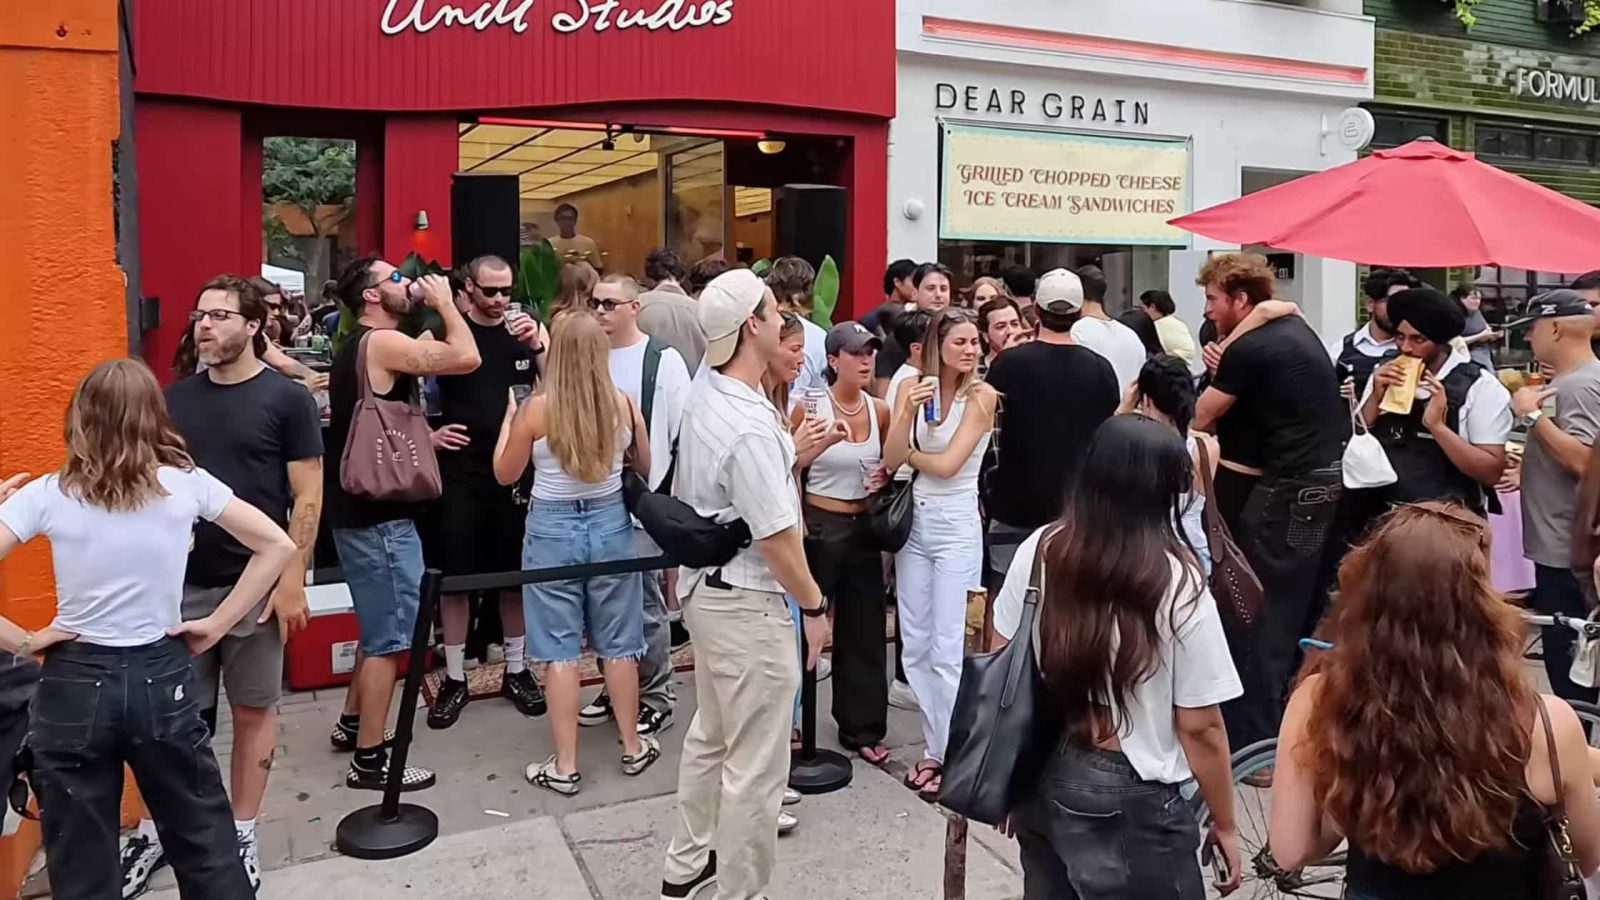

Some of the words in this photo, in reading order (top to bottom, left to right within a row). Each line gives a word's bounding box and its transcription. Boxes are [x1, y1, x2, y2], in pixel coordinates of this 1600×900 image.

[935, 83, 1026, 115] DEAR
[1042, 93, 1149, 125] GRAIN
[957, 164, 1024, 186] GRILLED
[1029, 168, 1111, 188] CHOPPED
[1116, 174, 1182, 191] CHEESE
[963, 190, 996, 206] ICE
[1001, 191, 1062, 210] CREAM
[1067, 194, 1176, 215] SANDWICHES
